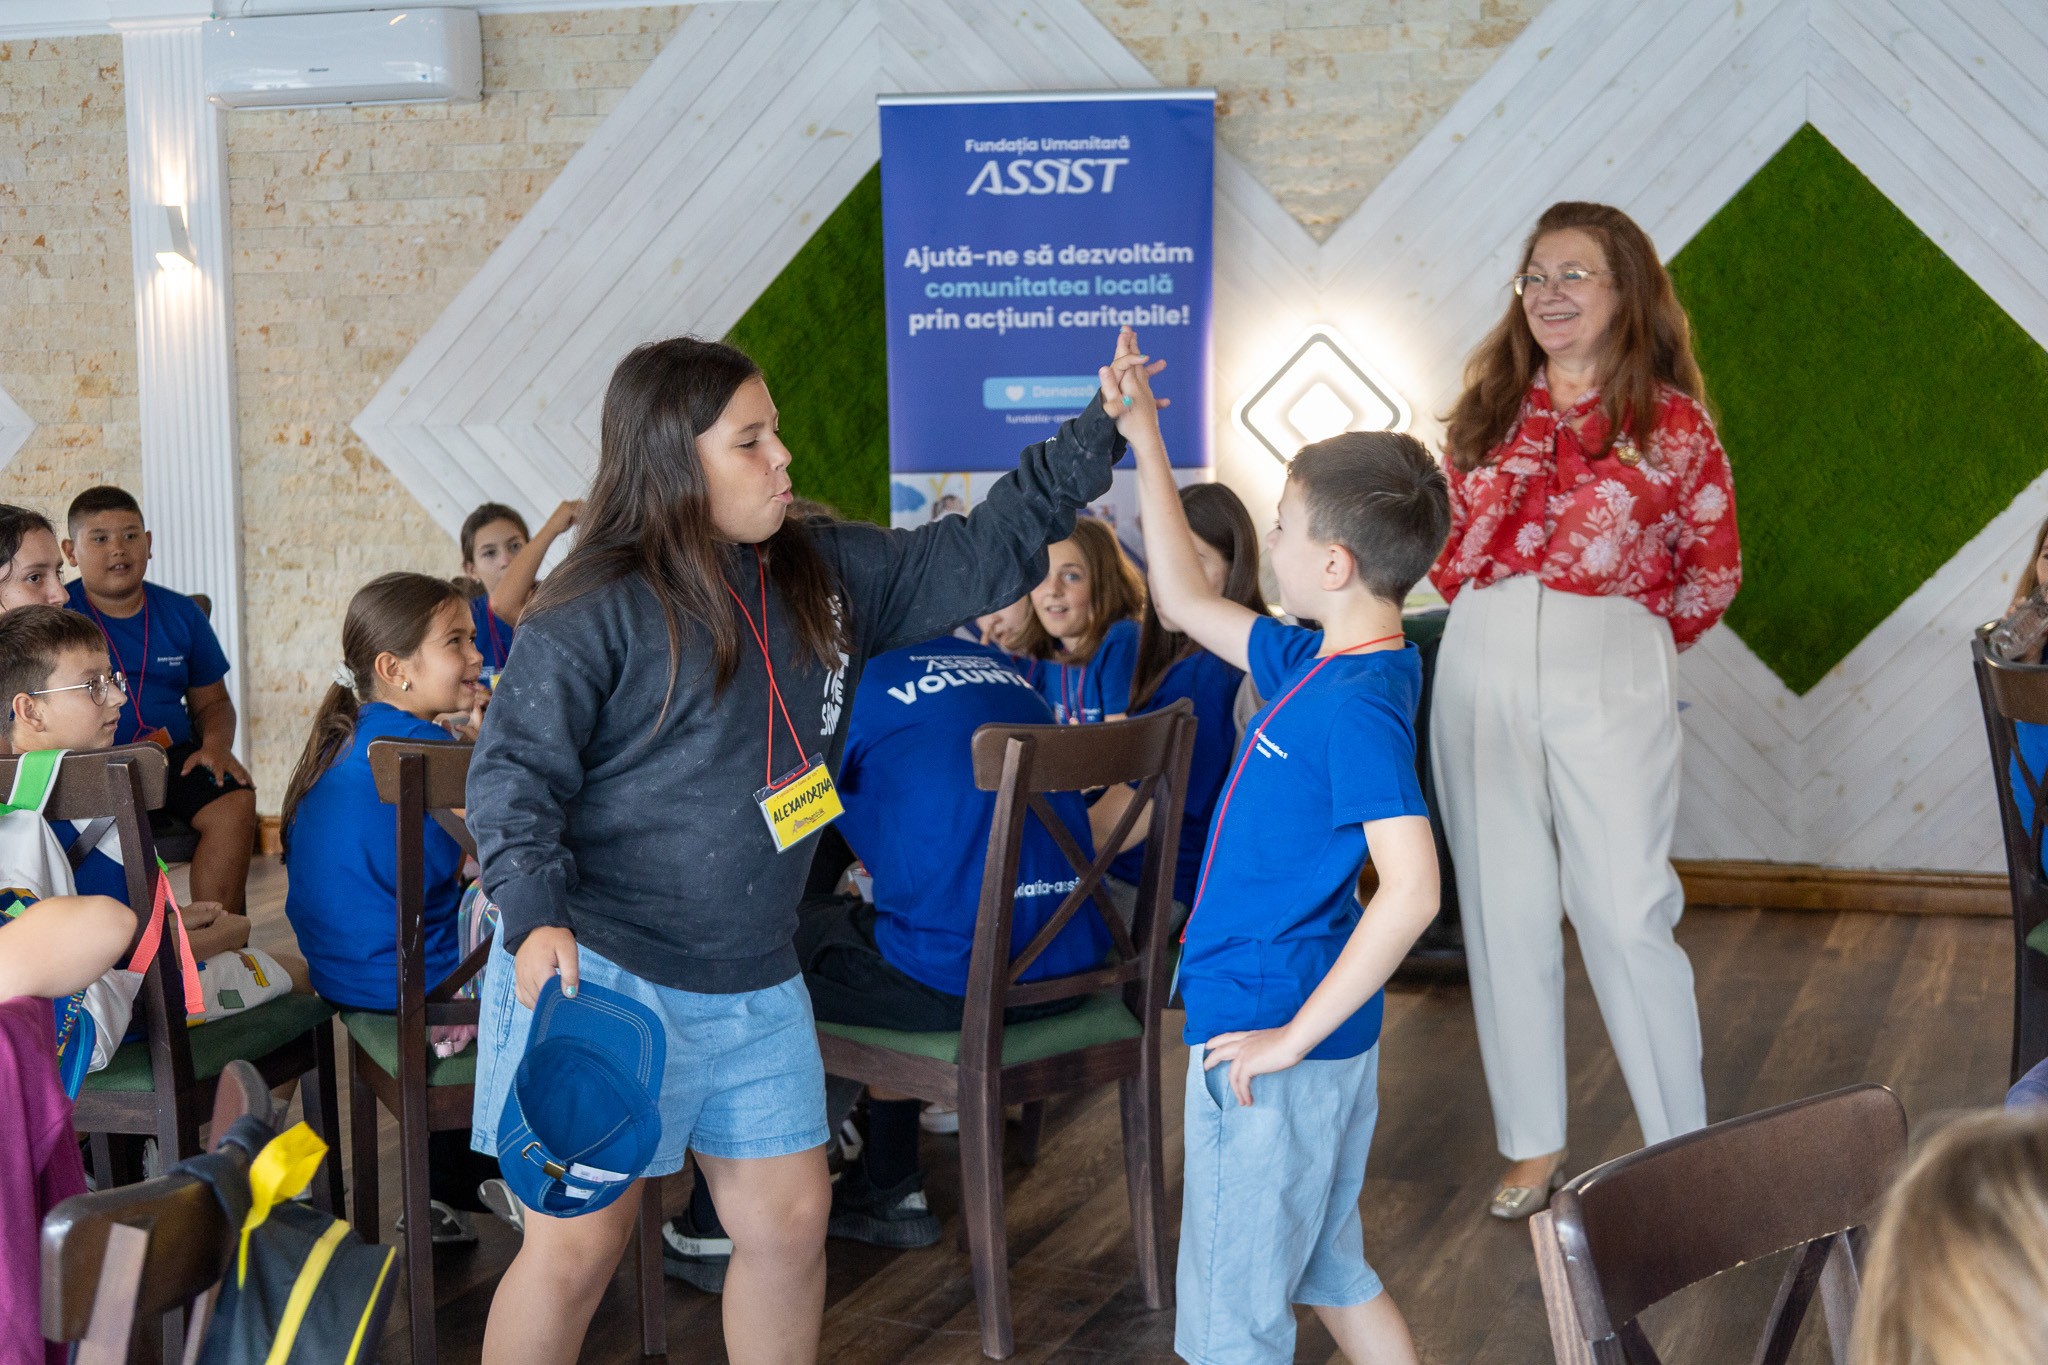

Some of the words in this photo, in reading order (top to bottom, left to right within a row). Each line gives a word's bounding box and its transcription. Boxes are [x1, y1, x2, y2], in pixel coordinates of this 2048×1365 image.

[965, 137, 1038, 155] Fundația
[1041, 135, 1131, 151] Umanitară
[966, 158, 1130, 196] ASSIST
[903, 245, 1019, 274] Ajută-ne
[1023, 244, 1054, 267] să
[1058, 241, 1194, 265] dezvoltăm
[924, 275, 1090, 299] comunitatea
[1095, 273, 1174, 296] locală
[908, 307, 960, 337] prin
[964, 306, 1054, 336] acțiuni
[1058, 304, 1191, 328] caritabile!
[773, 777, 834, 825] ALEXANDRINA
